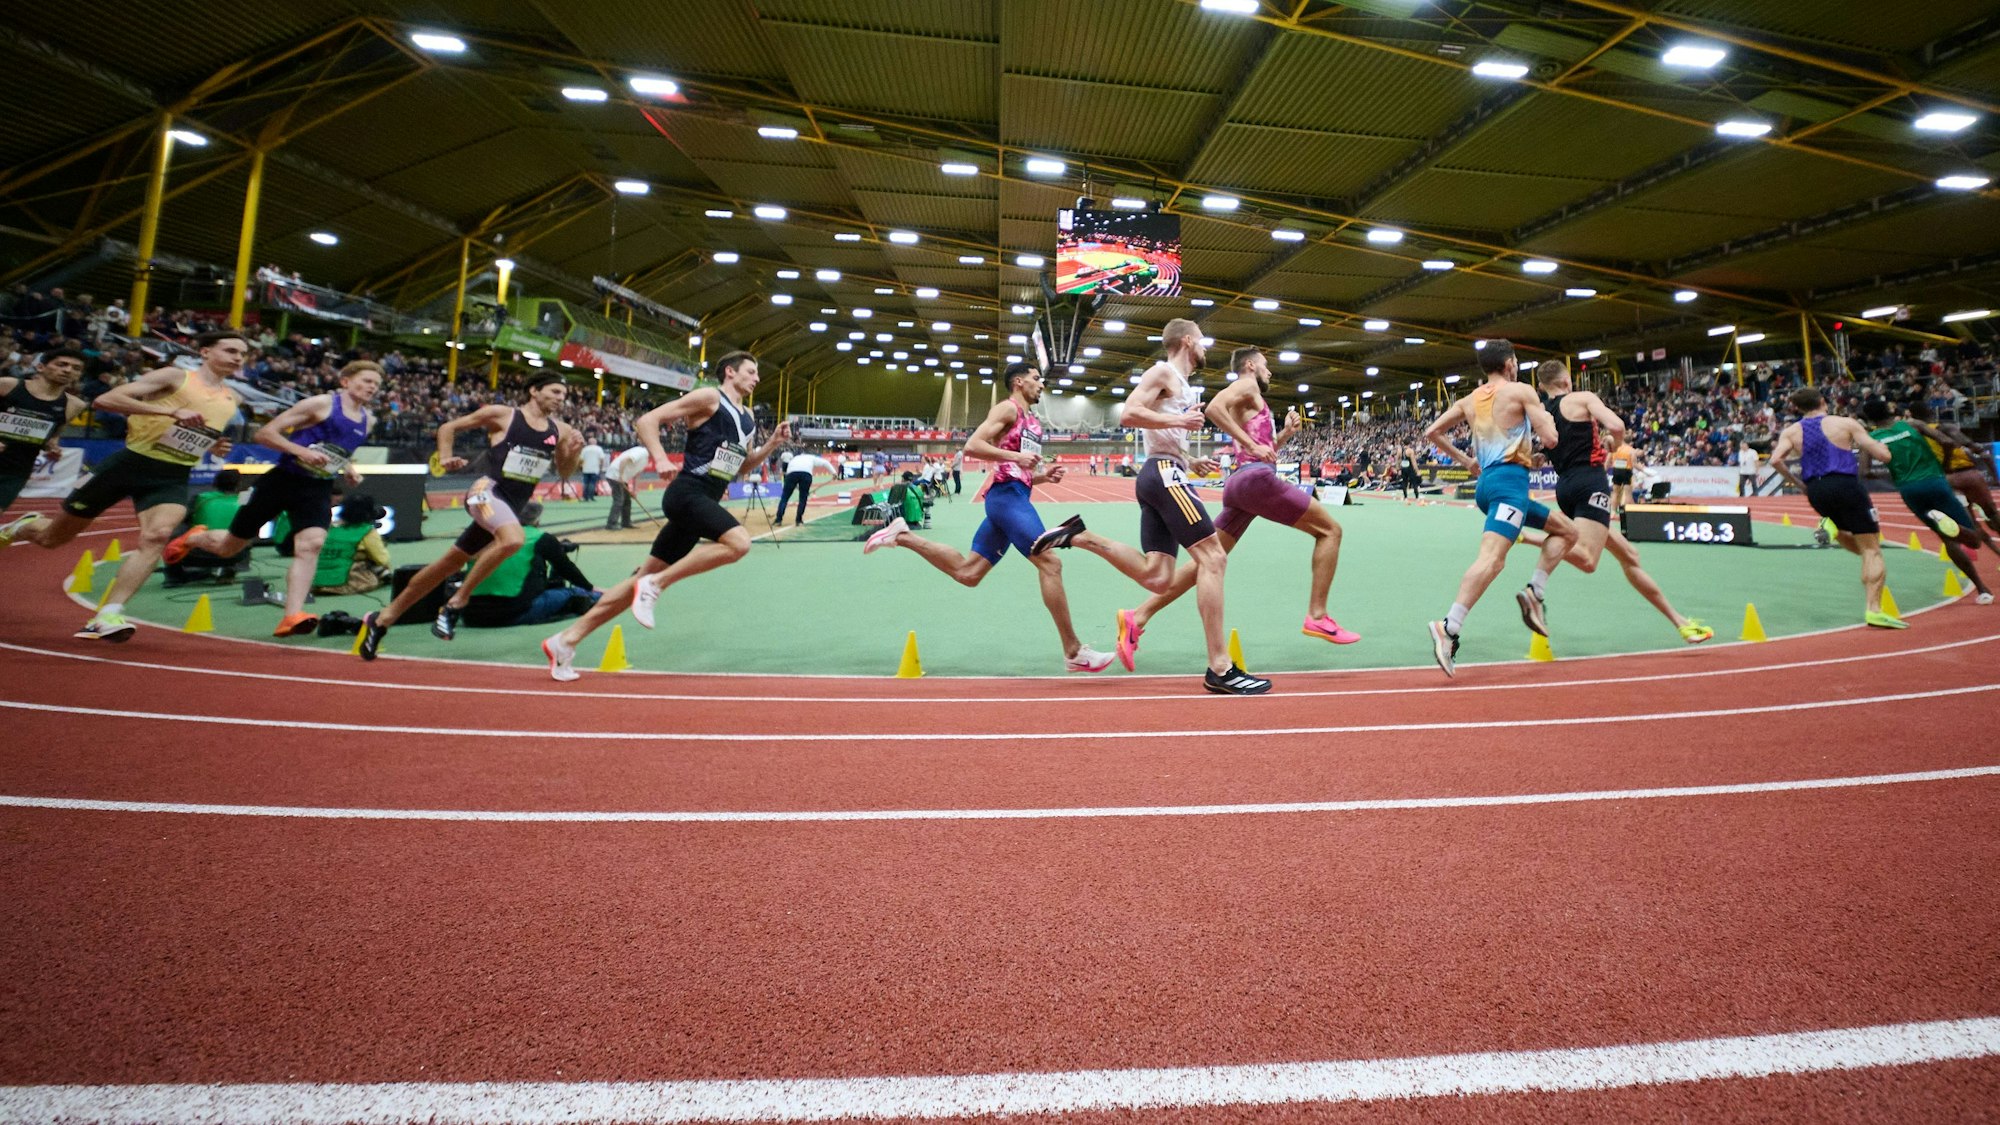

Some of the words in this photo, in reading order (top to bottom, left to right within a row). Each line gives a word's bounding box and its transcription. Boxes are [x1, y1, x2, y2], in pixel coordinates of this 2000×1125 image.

[1172, 470, 1181, 482] 4
[1594, 494, 1609, 508] 13
[1506, 507, 1517, 521] 7
[1663, 521, 1735, 543] 1:48.3
